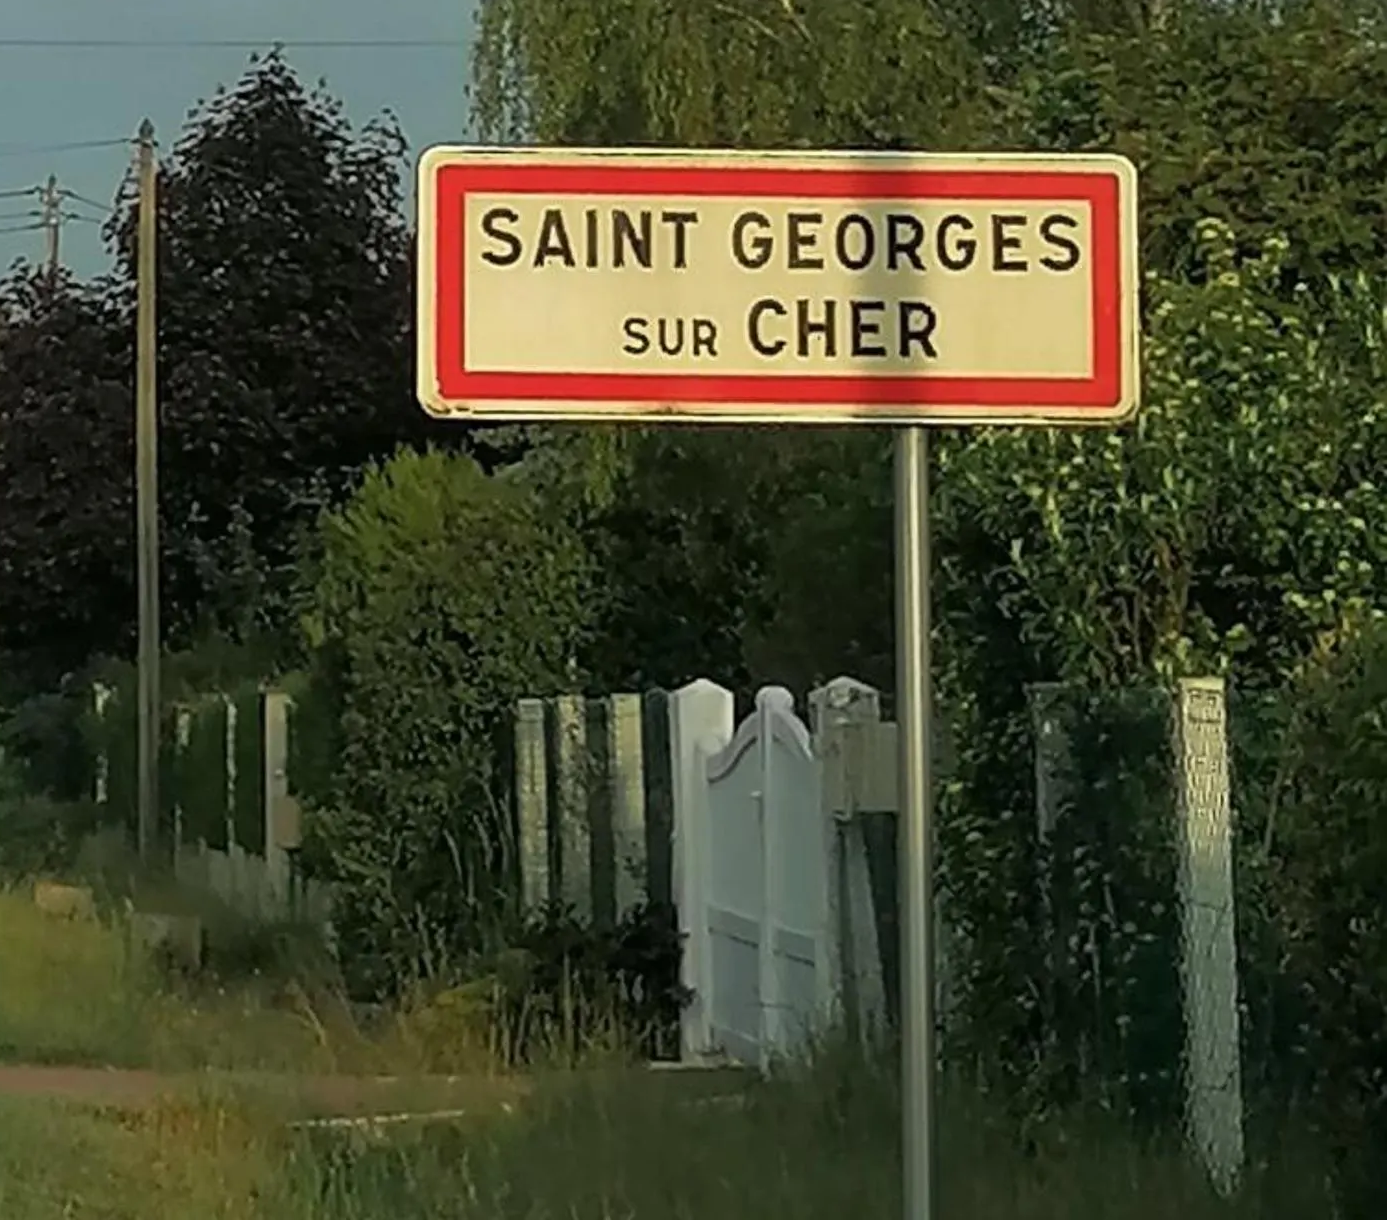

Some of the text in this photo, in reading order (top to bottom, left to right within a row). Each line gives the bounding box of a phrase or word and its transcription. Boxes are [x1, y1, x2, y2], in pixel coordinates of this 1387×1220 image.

[481, 208, 1082, 272] SAINT GEORGES
[622, 299, 939, 359] SUR CHER
